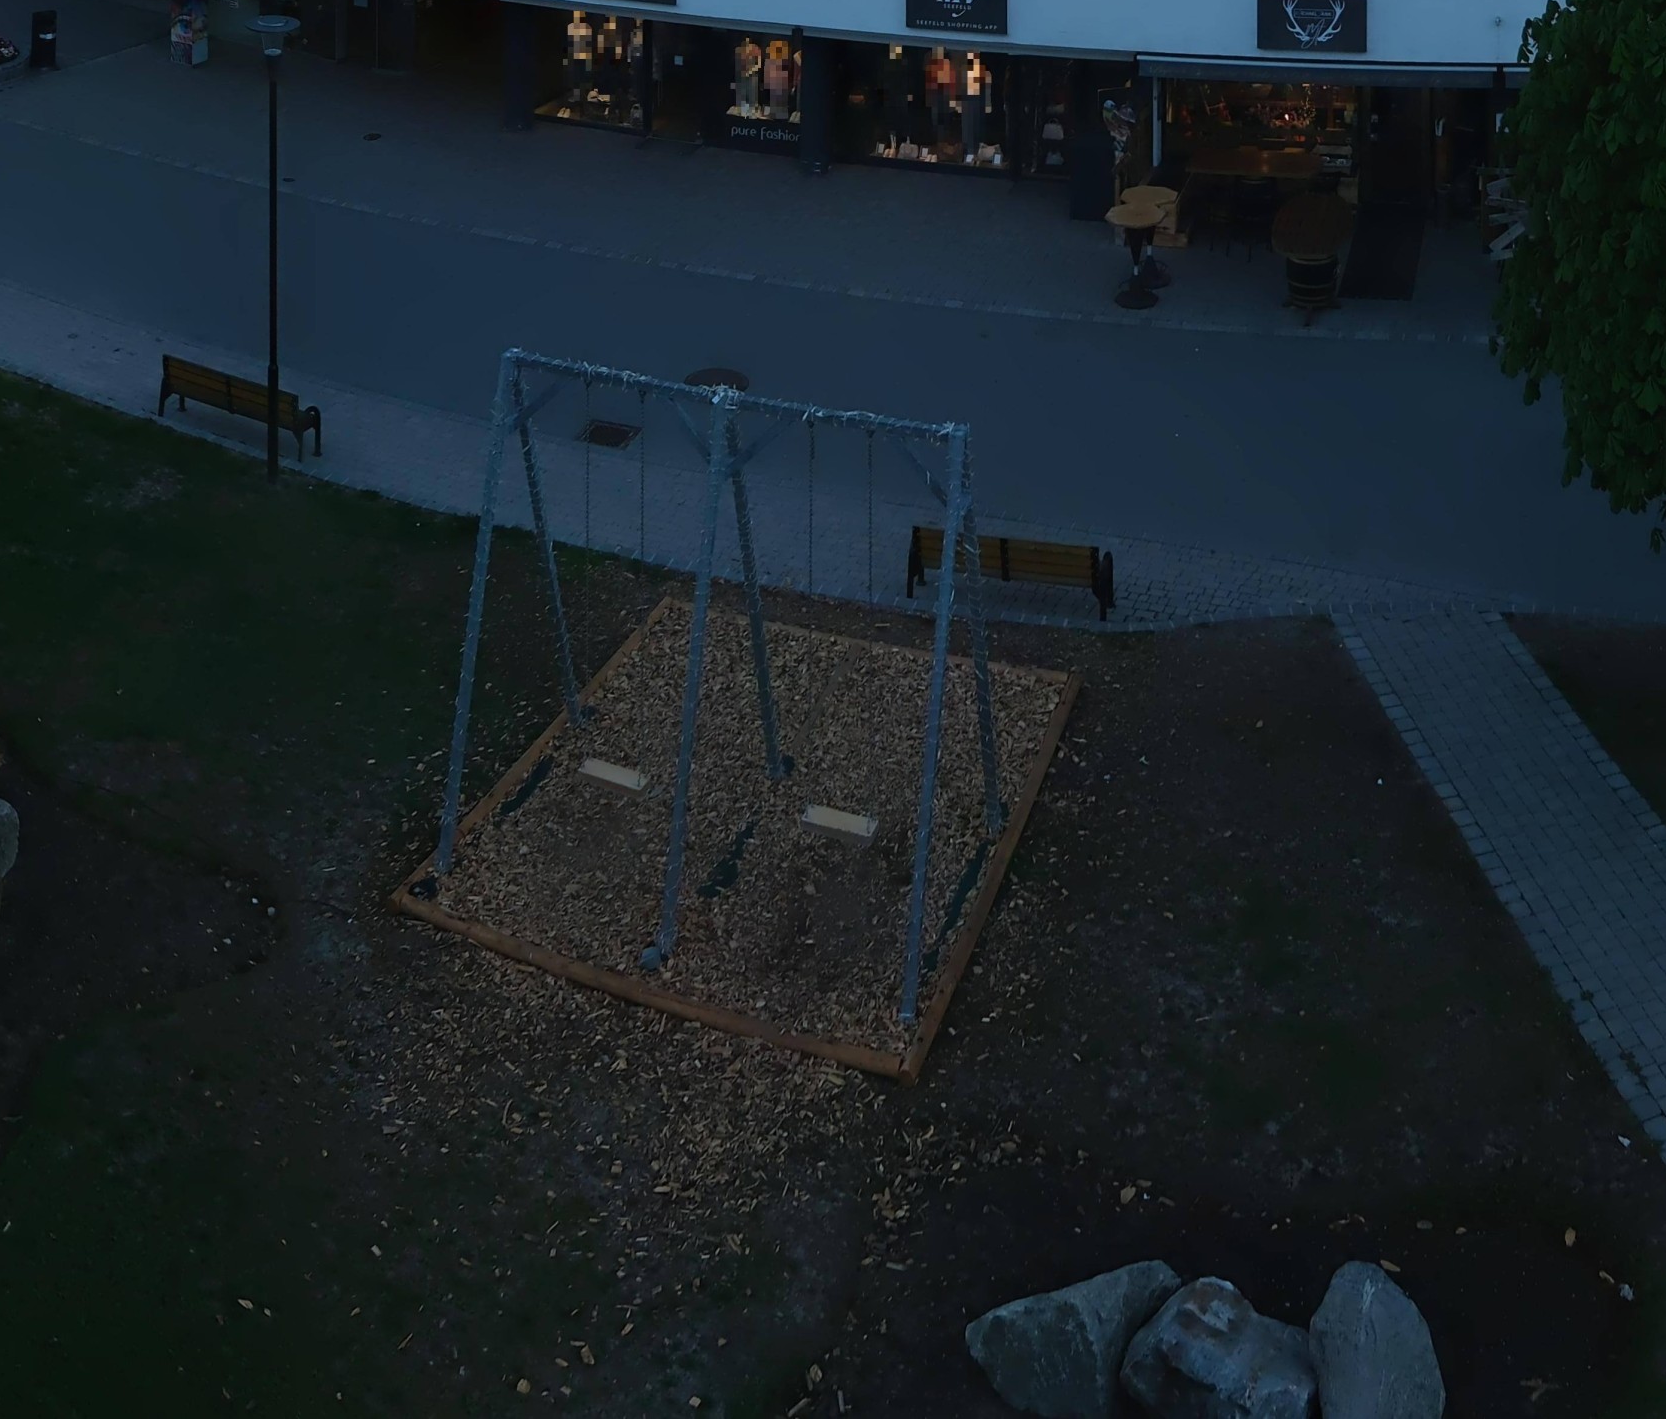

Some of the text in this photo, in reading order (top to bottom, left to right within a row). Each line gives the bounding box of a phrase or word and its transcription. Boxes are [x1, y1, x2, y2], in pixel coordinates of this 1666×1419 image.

[916, 19, 945, 27] SEEFELD
[947, 21, 982, 29] SHOPPING
[730, 126, 757, 137] pure
